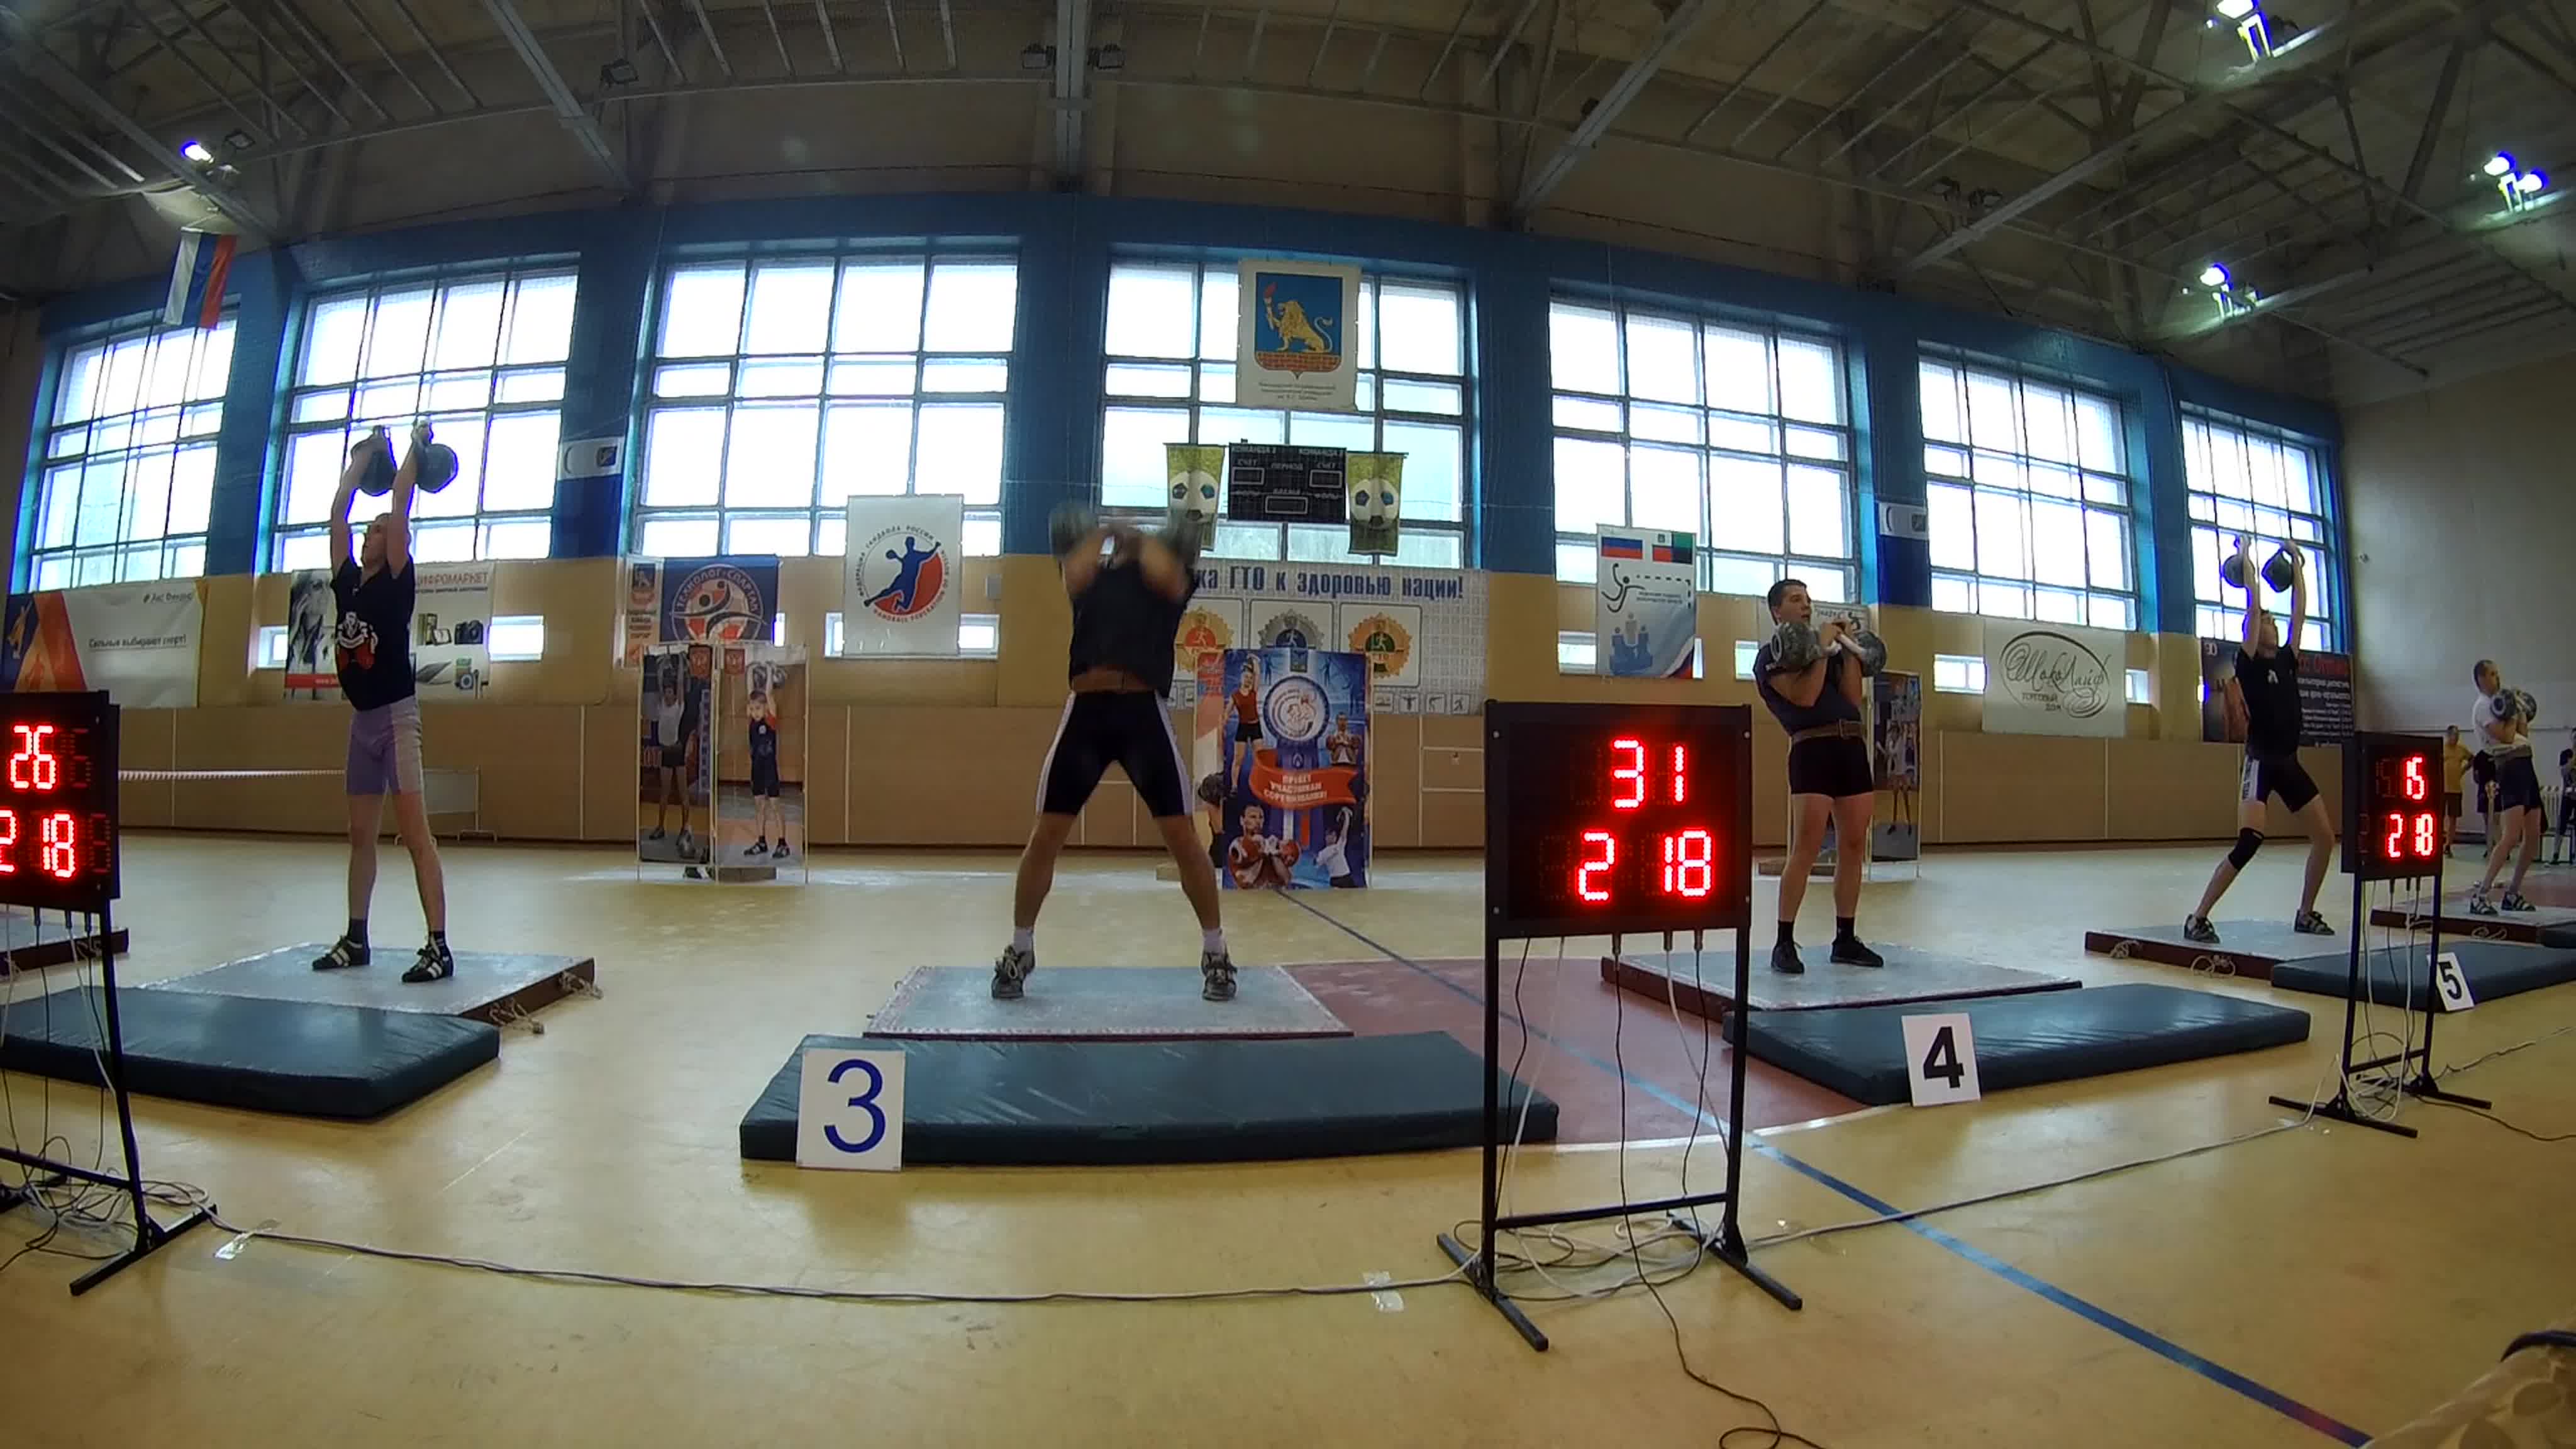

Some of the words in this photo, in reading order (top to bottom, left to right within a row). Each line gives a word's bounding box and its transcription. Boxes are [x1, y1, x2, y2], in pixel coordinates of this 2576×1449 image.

[1230, 565, 1265, 591] ГТО
[1275, 572, 1287, 591] к
[1297, 572, 1391, 599] здоровью
[1402, 576, 1463, 600] нации!
[10, 724, 57, 790] 26
[1613, 738, 1685, 809] 31
[1578, 831, 1616, 901] 2
[1663, 830, 1712, 897] 18
[2388, 813, 2404, 858] 2
[2438, 960, 2462, 1000] 5
[1923, 1026, 1965, 1089] 4
[824, 1058, 886, 1154] 3
